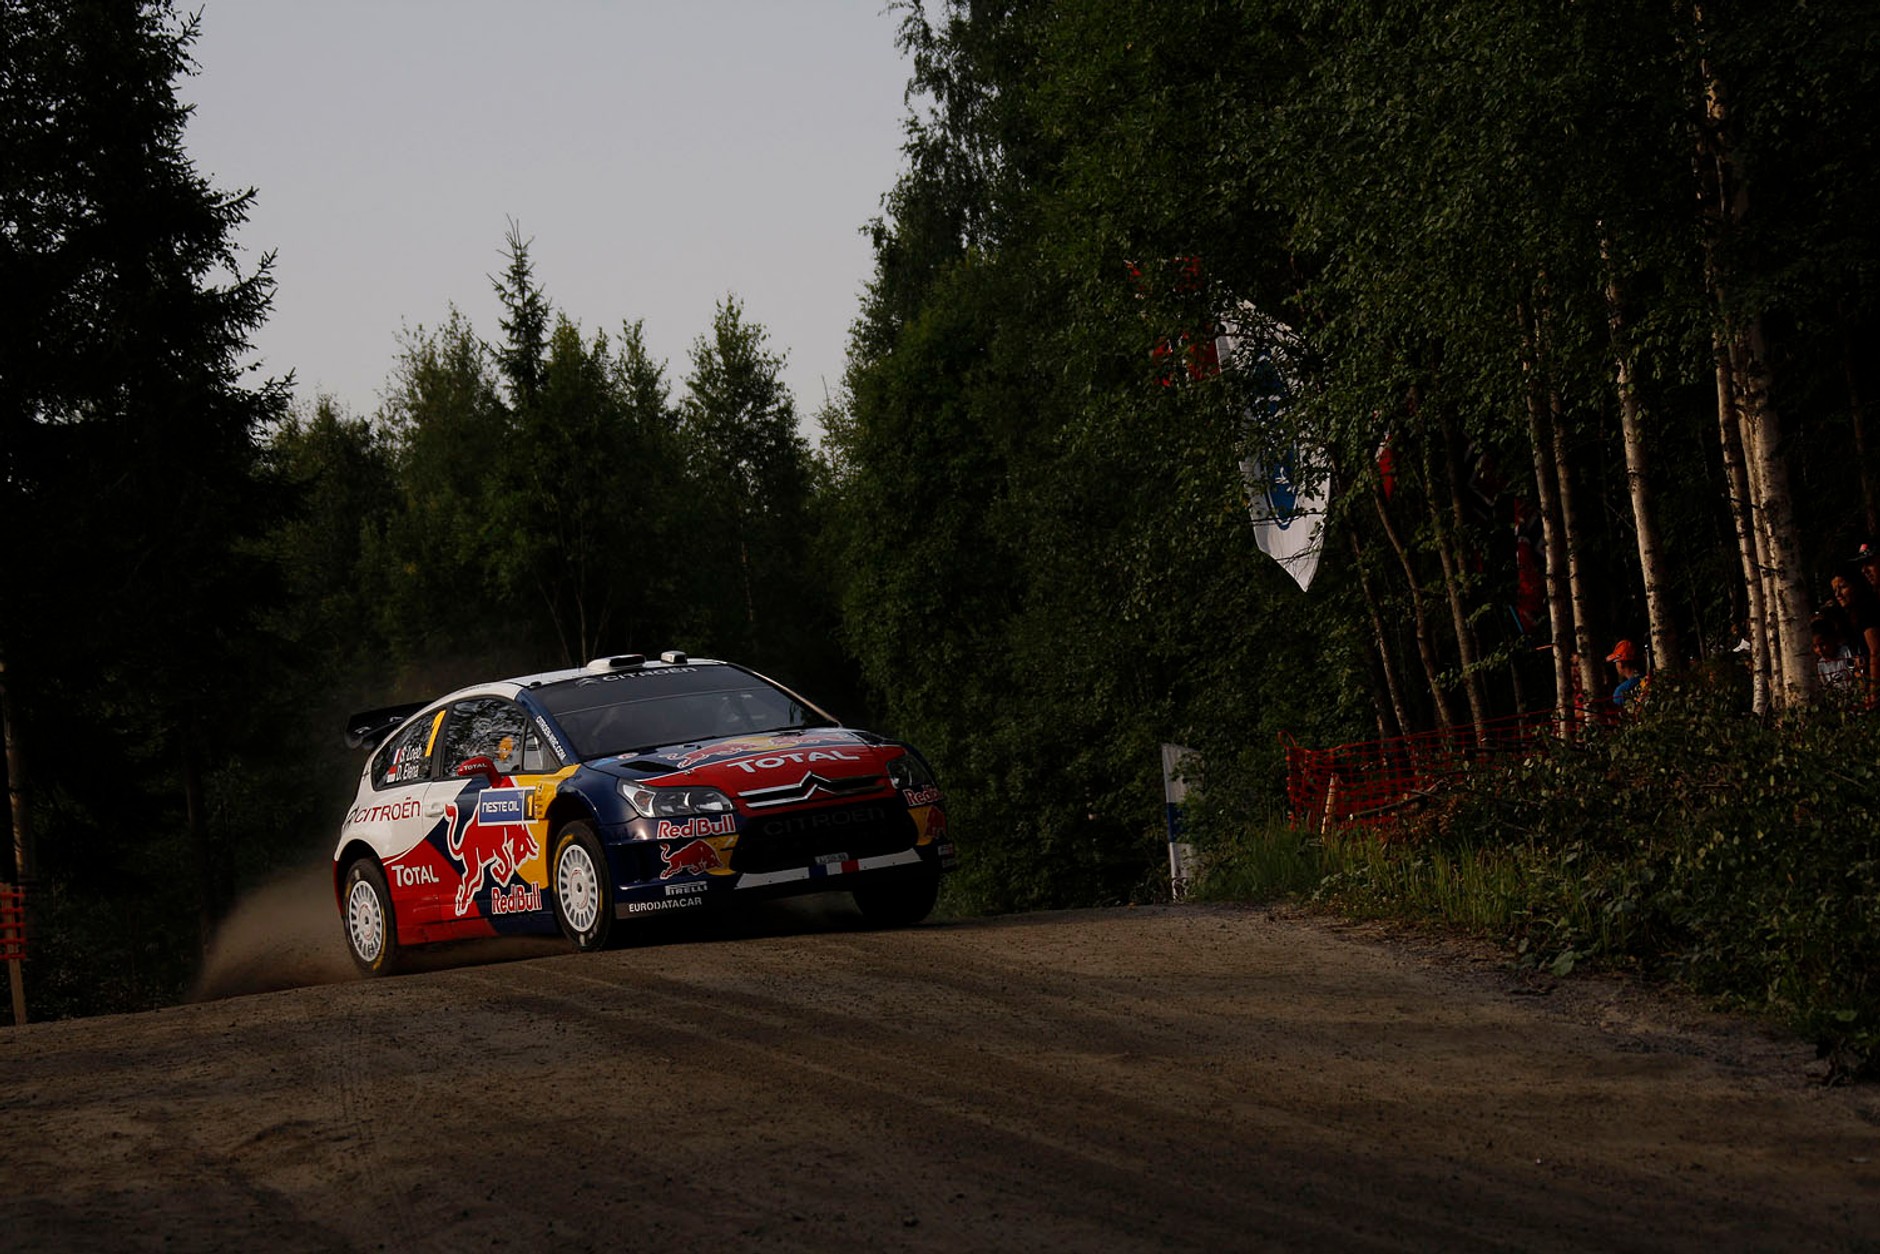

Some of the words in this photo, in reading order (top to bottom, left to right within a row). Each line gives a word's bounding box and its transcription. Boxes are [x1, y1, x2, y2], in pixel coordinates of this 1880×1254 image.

[463, 762, 488, 771] TOTAL
[726, 750, 861, 773] TOTAL
[481, 801, 507, 813] NESTE
[657, 817, 695, 840] Red
[695, 813, 736, 835] Bull
[391, 864, 440, 888] TOTAL
[664, 880, 709, 896] PIRELLI
[491, 884, 516, 915] Red
[516, 881, 543, 912] Bull
[628, 897, 703, 913] EURODATACAR
